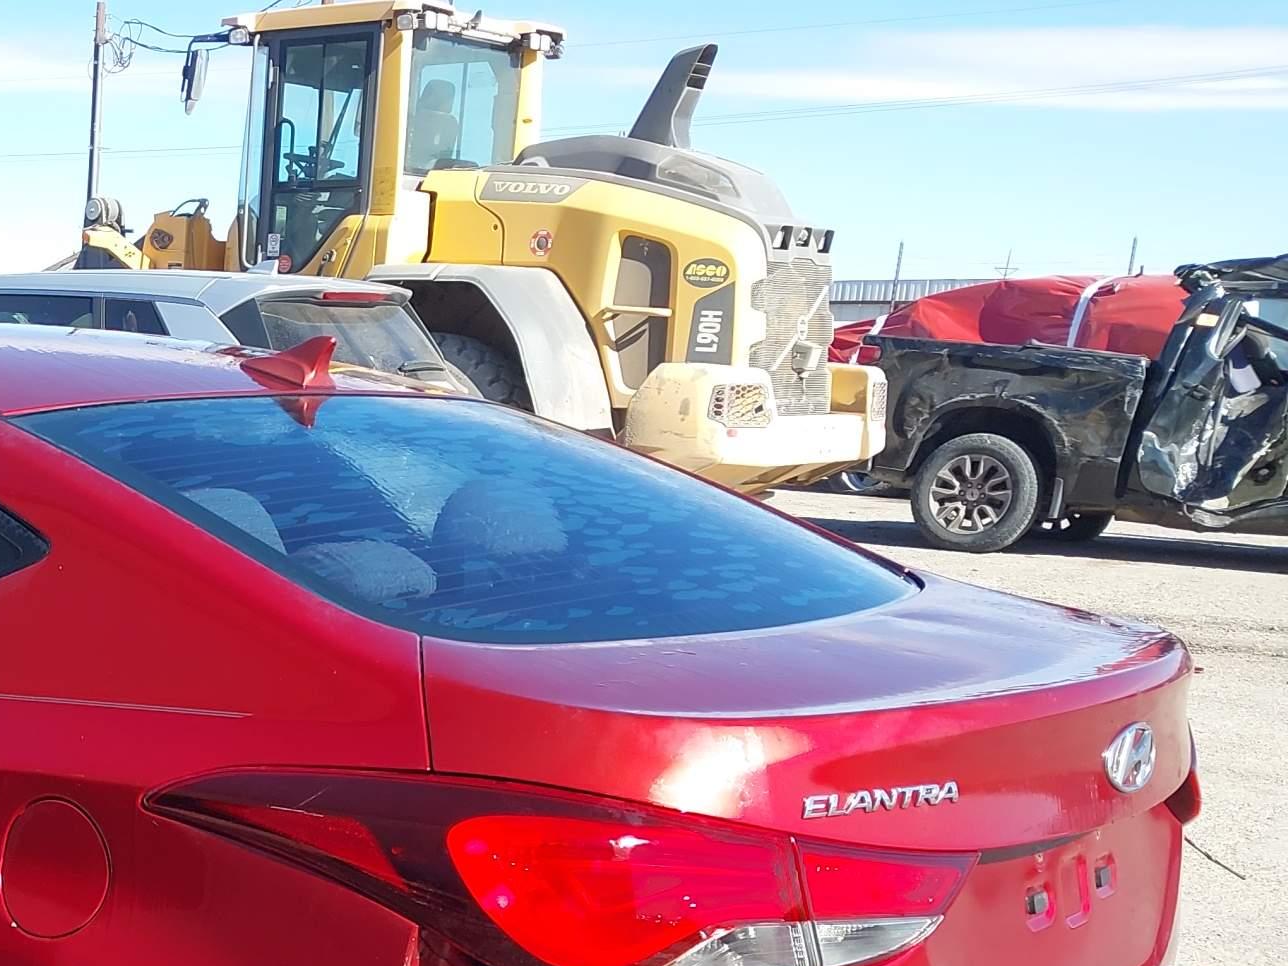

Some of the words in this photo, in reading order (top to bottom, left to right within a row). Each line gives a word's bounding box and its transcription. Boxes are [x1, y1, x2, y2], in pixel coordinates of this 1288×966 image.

[493, 181, 570, 196] VOLVO
[685, 263, 727, 277] ASCO
[695, 309, 724, 353] L90H
[803, 781, 959, 819] ELANTRA
